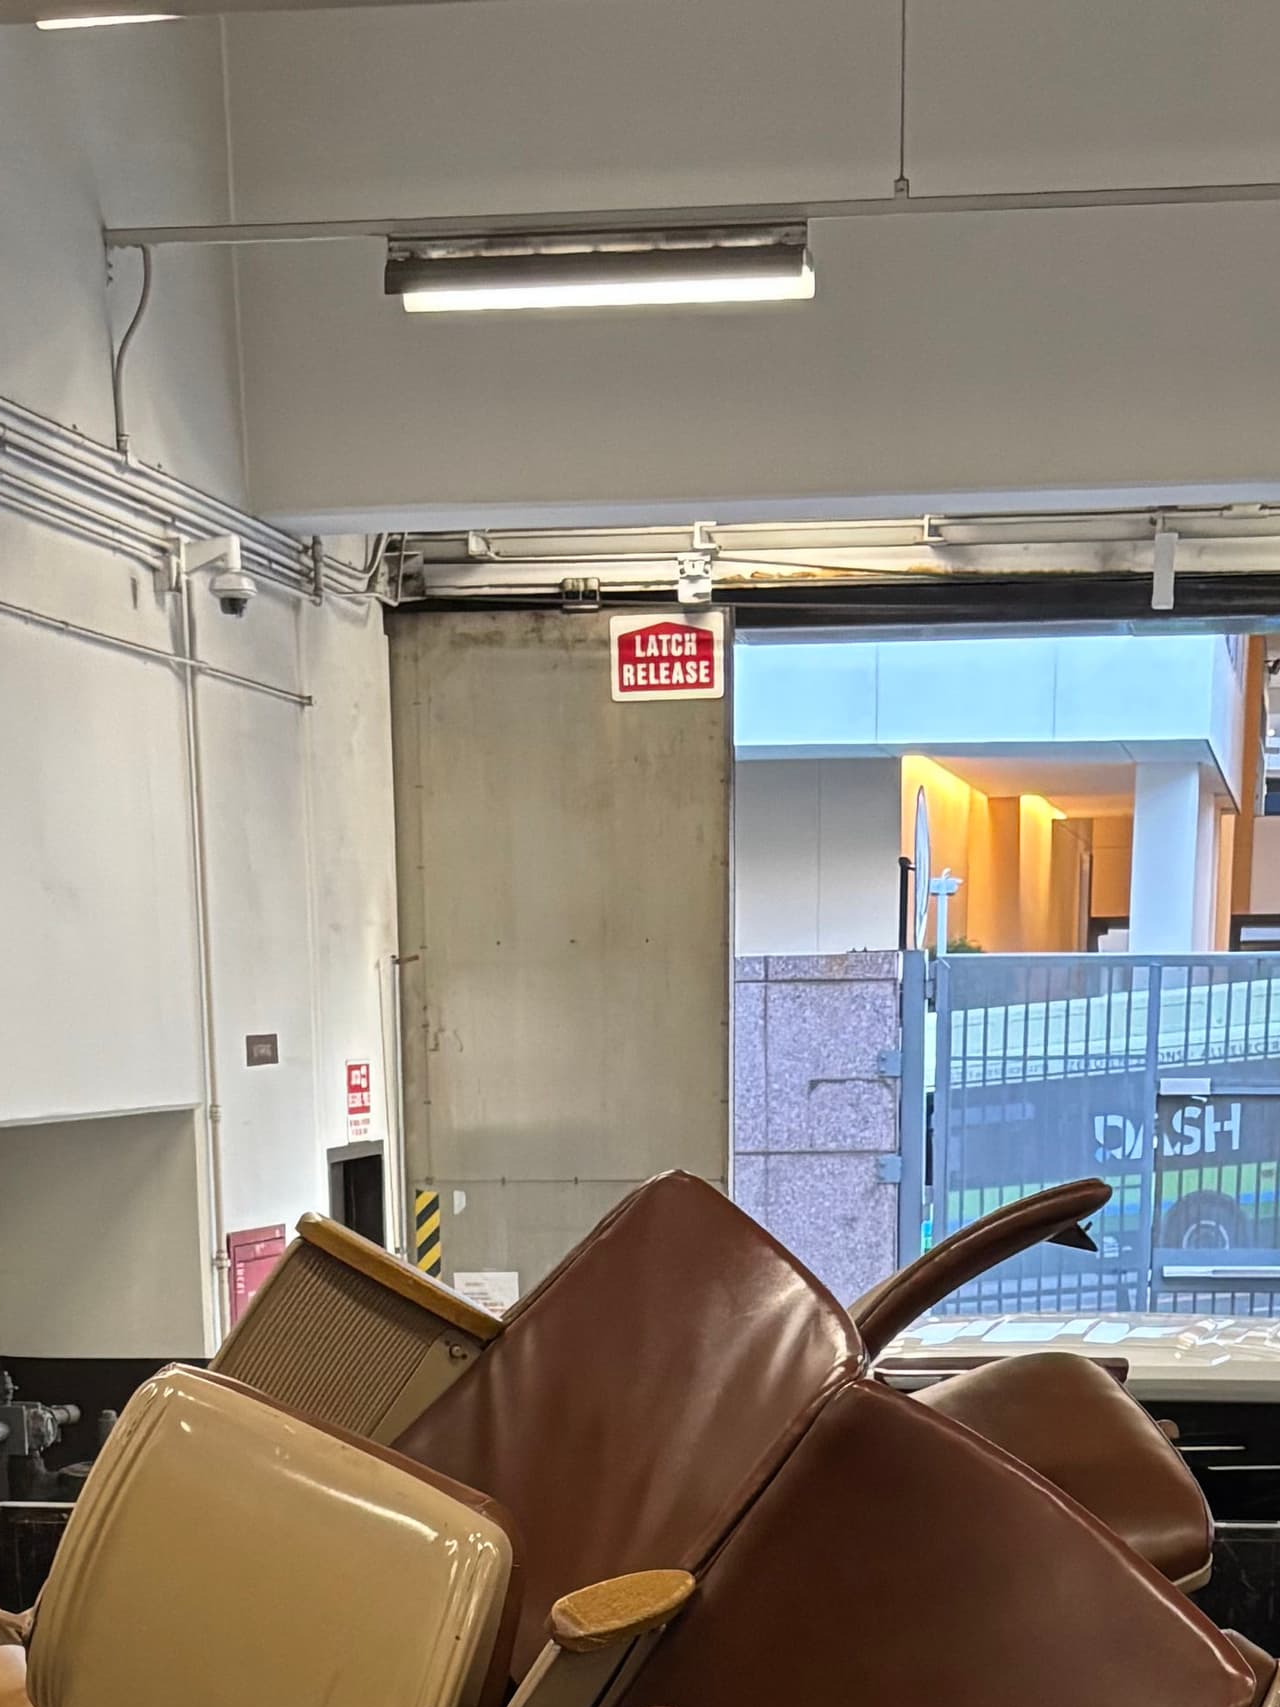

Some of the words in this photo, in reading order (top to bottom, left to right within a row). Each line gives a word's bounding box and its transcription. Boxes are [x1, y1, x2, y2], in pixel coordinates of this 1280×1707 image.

[635, 632, 697, 658] LATCH
[622, 660, 710, 687] RELEASE
[1093, 1101, 1243, 1163] DASH
